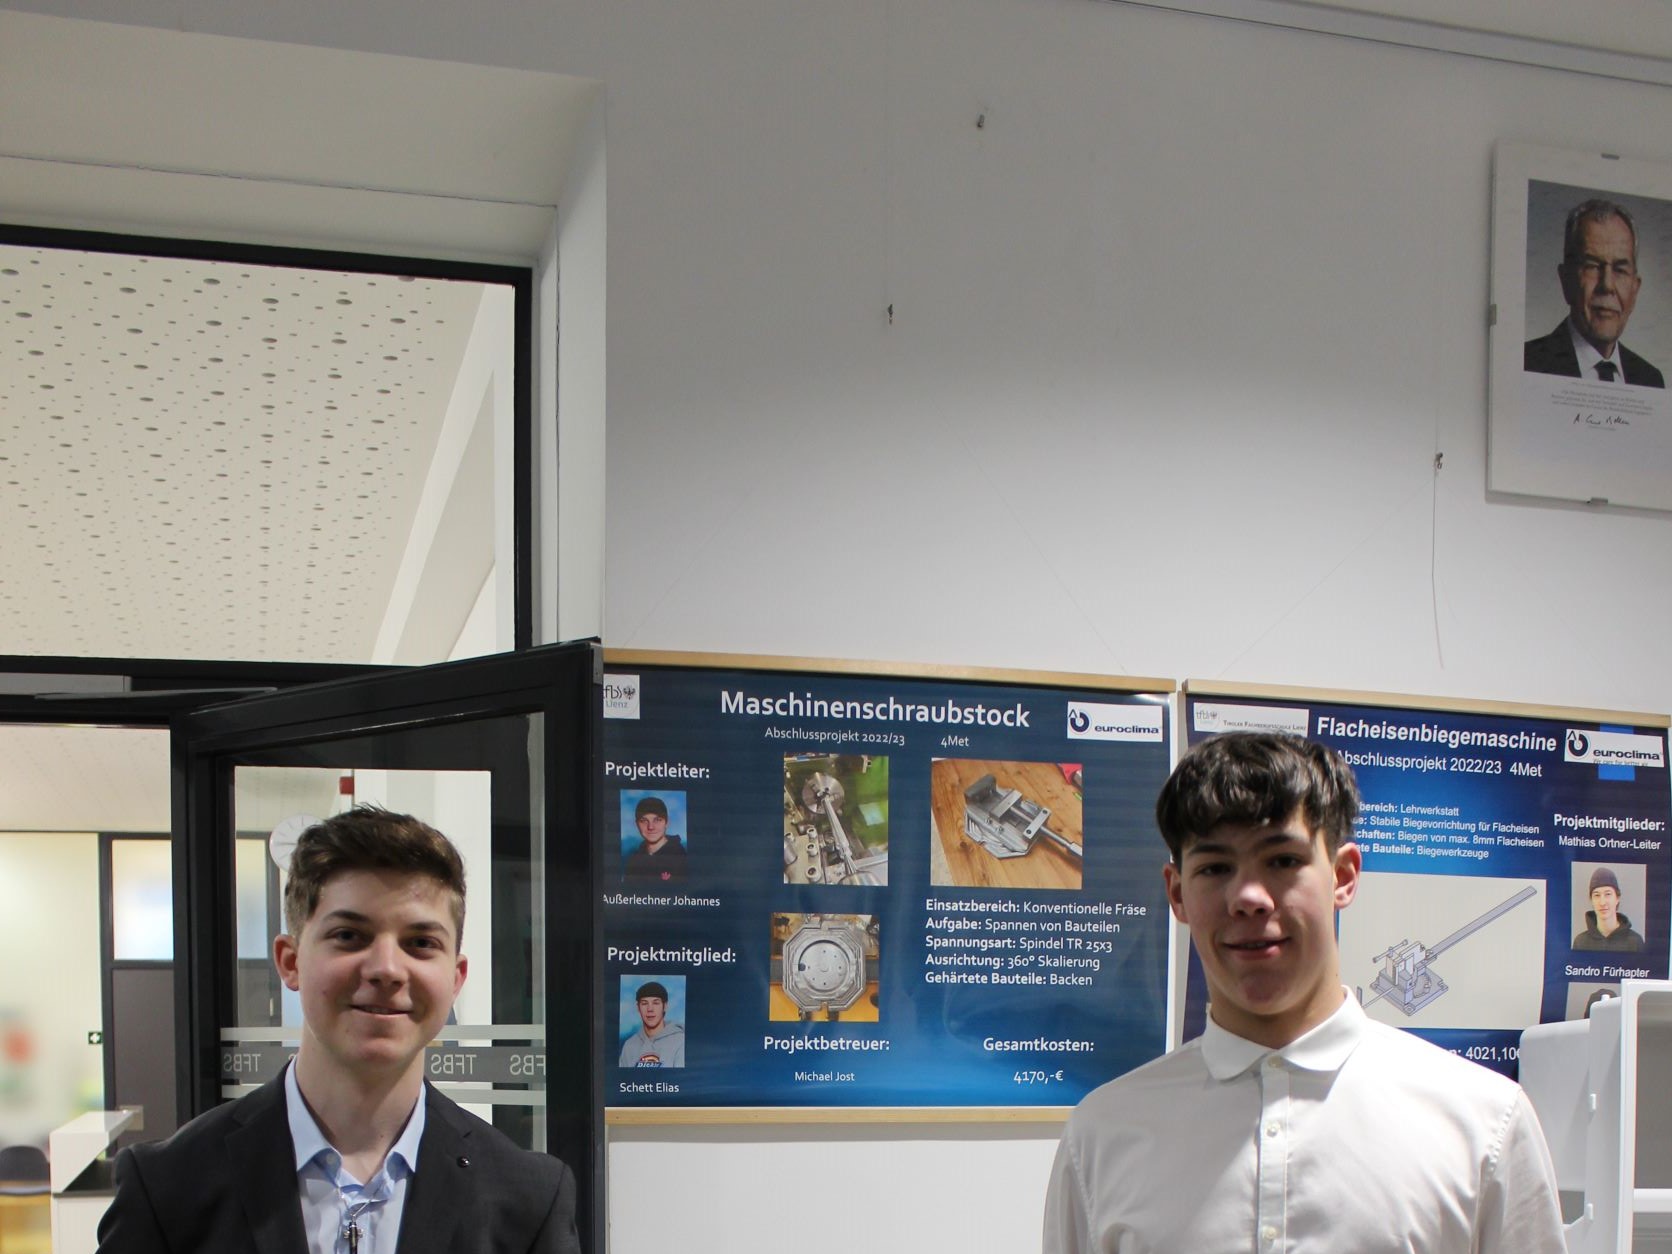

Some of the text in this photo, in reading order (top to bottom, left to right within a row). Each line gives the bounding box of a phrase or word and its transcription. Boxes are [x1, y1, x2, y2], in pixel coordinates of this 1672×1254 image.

[720, 690, 1030, 727] Maschinenschraubstock
[764, 726, 905, 747] Abschlussprojekt 2022/23
[1094, 724, 1160, 734] euroclima
[1317, 716, 1557, 751] Flacheisenbiegemaschine
[940, 736, 969, 748] 4Met
[1593, 749, 1660, 760] euroclima
[605, 761, 710, 780] Projektleiter:
[1450, 757, 1502, 775] 2022/23
[1510, 762, 1543, 778] 4Met
[1359, 801, 1459, 817] bereich: Lehrwerkstatt
[1369, 815, 1401, 827] Stabile
[1403, 817, 1476, 832] Biegevorrichtung
[1478, 821, 1491, 832] für
[1493, 822, 1540, 834] Flacheisen
[1554, 813, 1665, 832] Projektmitglieder:
[1356, 829, 1545, 848] chaften: Biegen von max. 8mm Flacheisen
[1558, 835, 1661, 850] Mathias Ortner-Leiter
[1372, 843, 1415, 856] Bauteile:
[1417, 845, 1489, 860] Biegewerkzeuge
[673, 895, 721, 906] Johannes
[926, 899, 1147, 916] Einsatzbereich: Konventionelle Fräse
[925, 917, 1120, 934] Aufgabe: Spannen von Bauteilen
[925, 935, 1113, 953] Spannungsart: Spindel TR 25x3
[607, 947, 736, 966] Projektmitglied:
[925, 954, 1101, 971] Ausrichtung: 360° Skalierung
[925, 971, 1093, 986] Gehärtete Bauteile: Backen
[1564, 965, 1650, 979] Sandro Fürhapter
[763, 1036, 890, 1055] Projektbetreuer:
[983, 1037, 1095, 1051] Gesamtkosten:
[794, 1071, 855, 1082] Michael Jost
[1013, 1070, 1064, 1084] 4170,-€
[619, 1082, 680, 1093] Schett Elias
